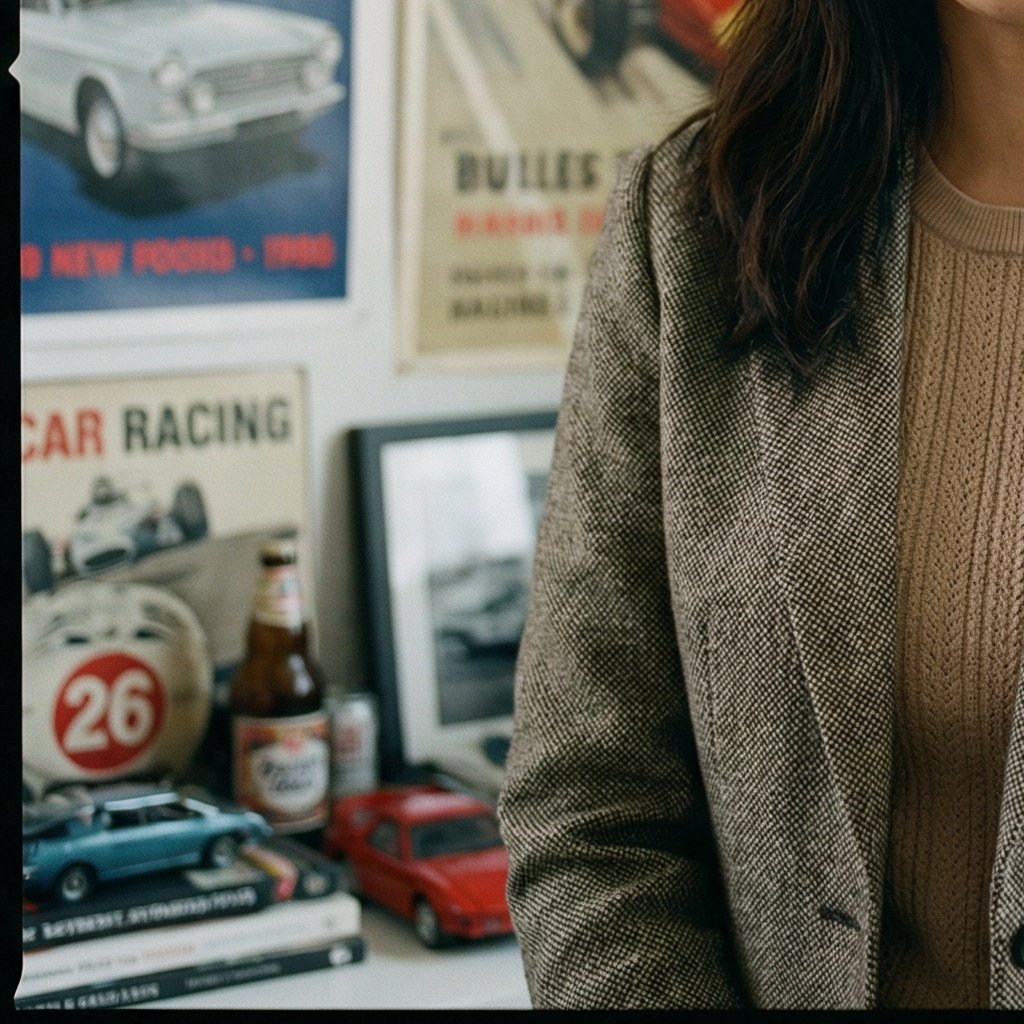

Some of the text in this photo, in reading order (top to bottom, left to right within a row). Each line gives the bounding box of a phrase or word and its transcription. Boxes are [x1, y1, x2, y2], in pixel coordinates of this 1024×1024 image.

[21, 396, 292, 463] CAR RACING
[62, 669, 157, 755] 26
